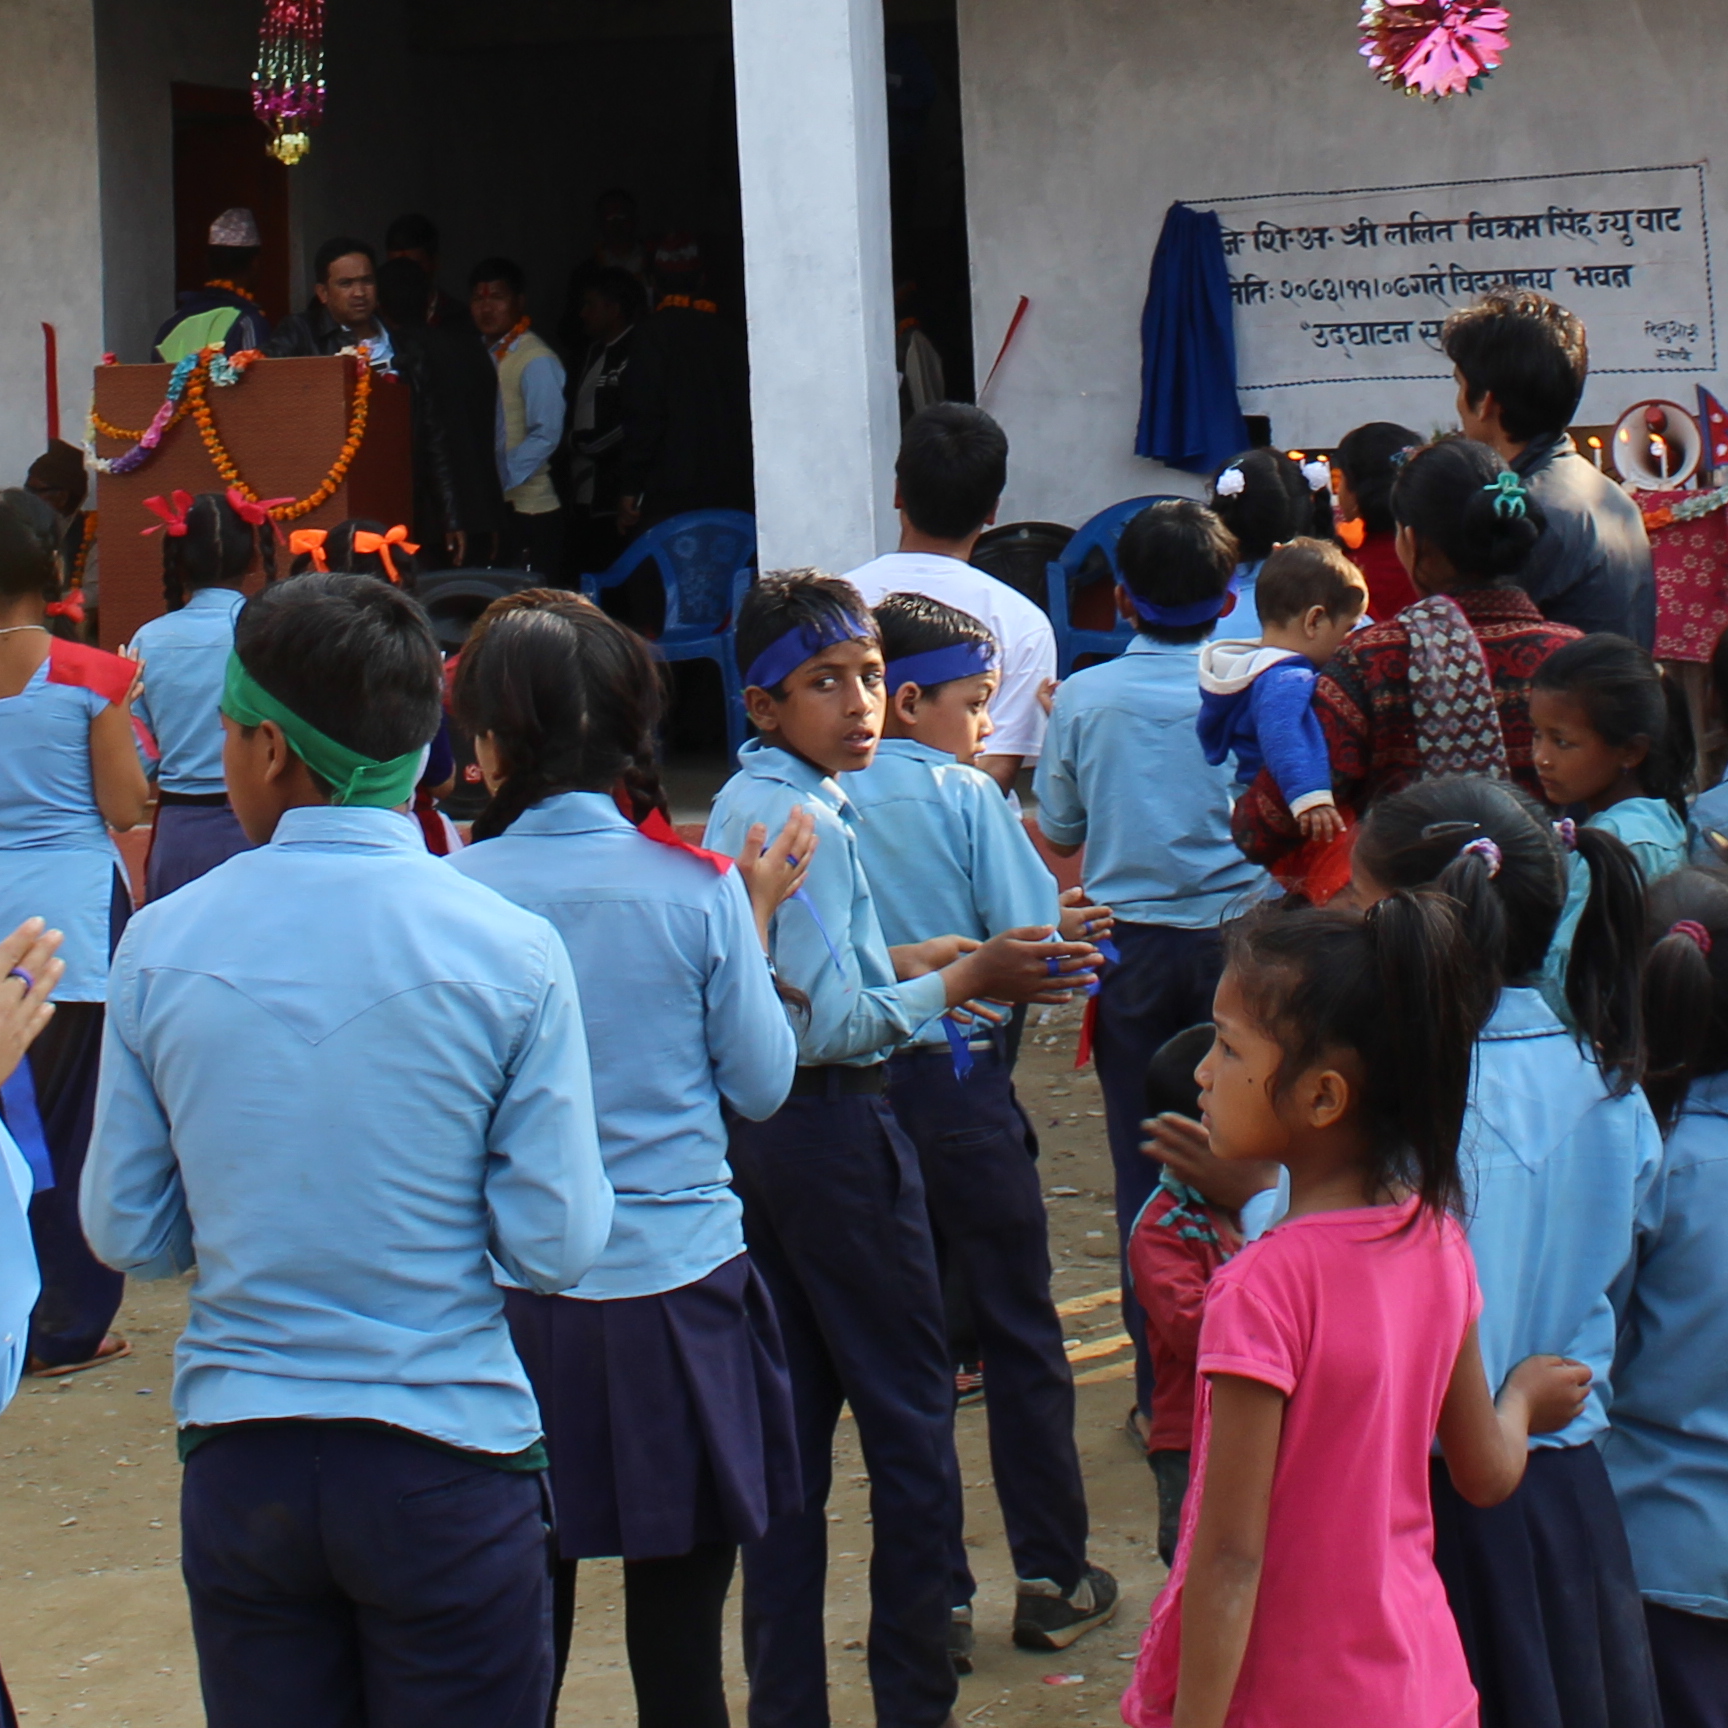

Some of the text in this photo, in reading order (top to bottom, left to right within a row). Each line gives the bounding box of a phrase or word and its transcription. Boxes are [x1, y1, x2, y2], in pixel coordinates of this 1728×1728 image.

[1341, 216, 1379, 248] श्री
[1384, 210, 1459, 246] ललित
[1566, 264, 1636, 289] भवन
